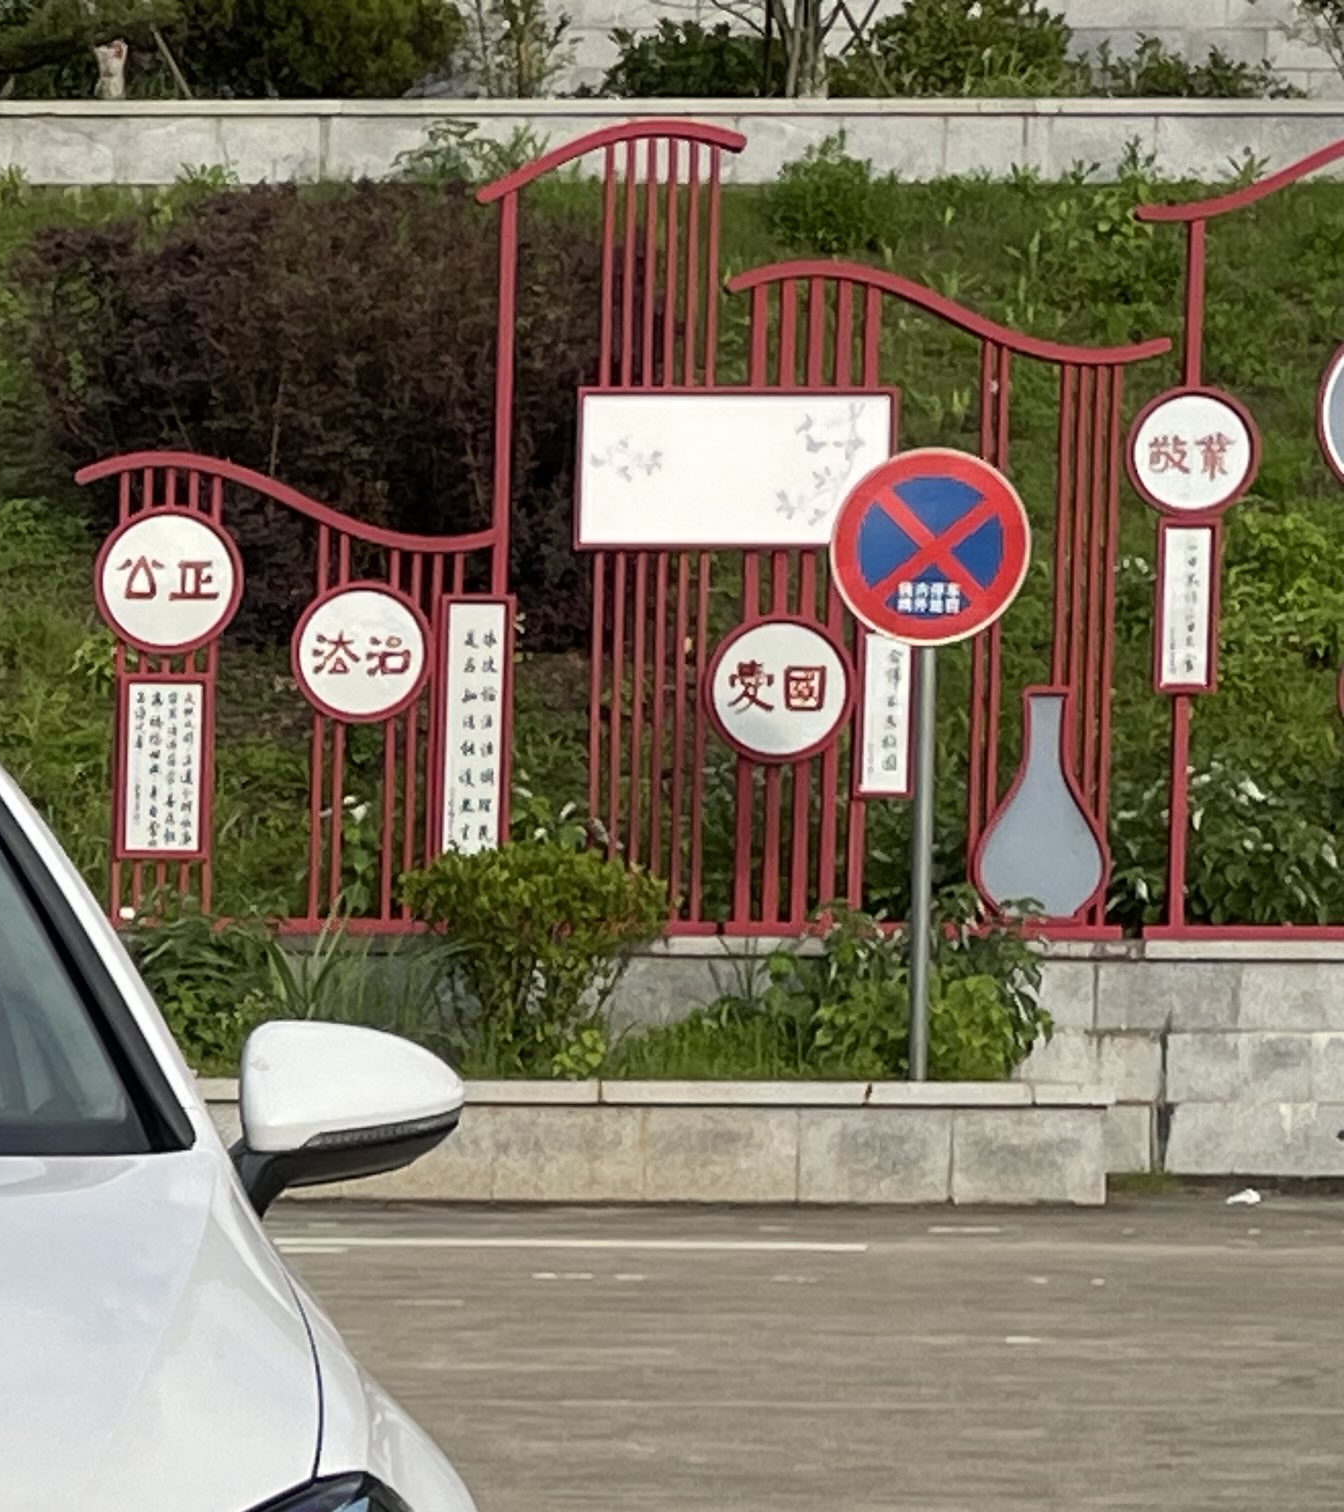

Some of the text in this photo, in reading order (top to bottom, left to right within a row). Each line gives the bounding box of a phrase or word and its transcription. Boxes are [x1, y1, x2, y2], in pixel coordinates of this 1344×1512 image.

[116, 555, 220, 601] 公正
[312, 630, 410, 676] 法治
[727, 660, 826, 714] 愛國
